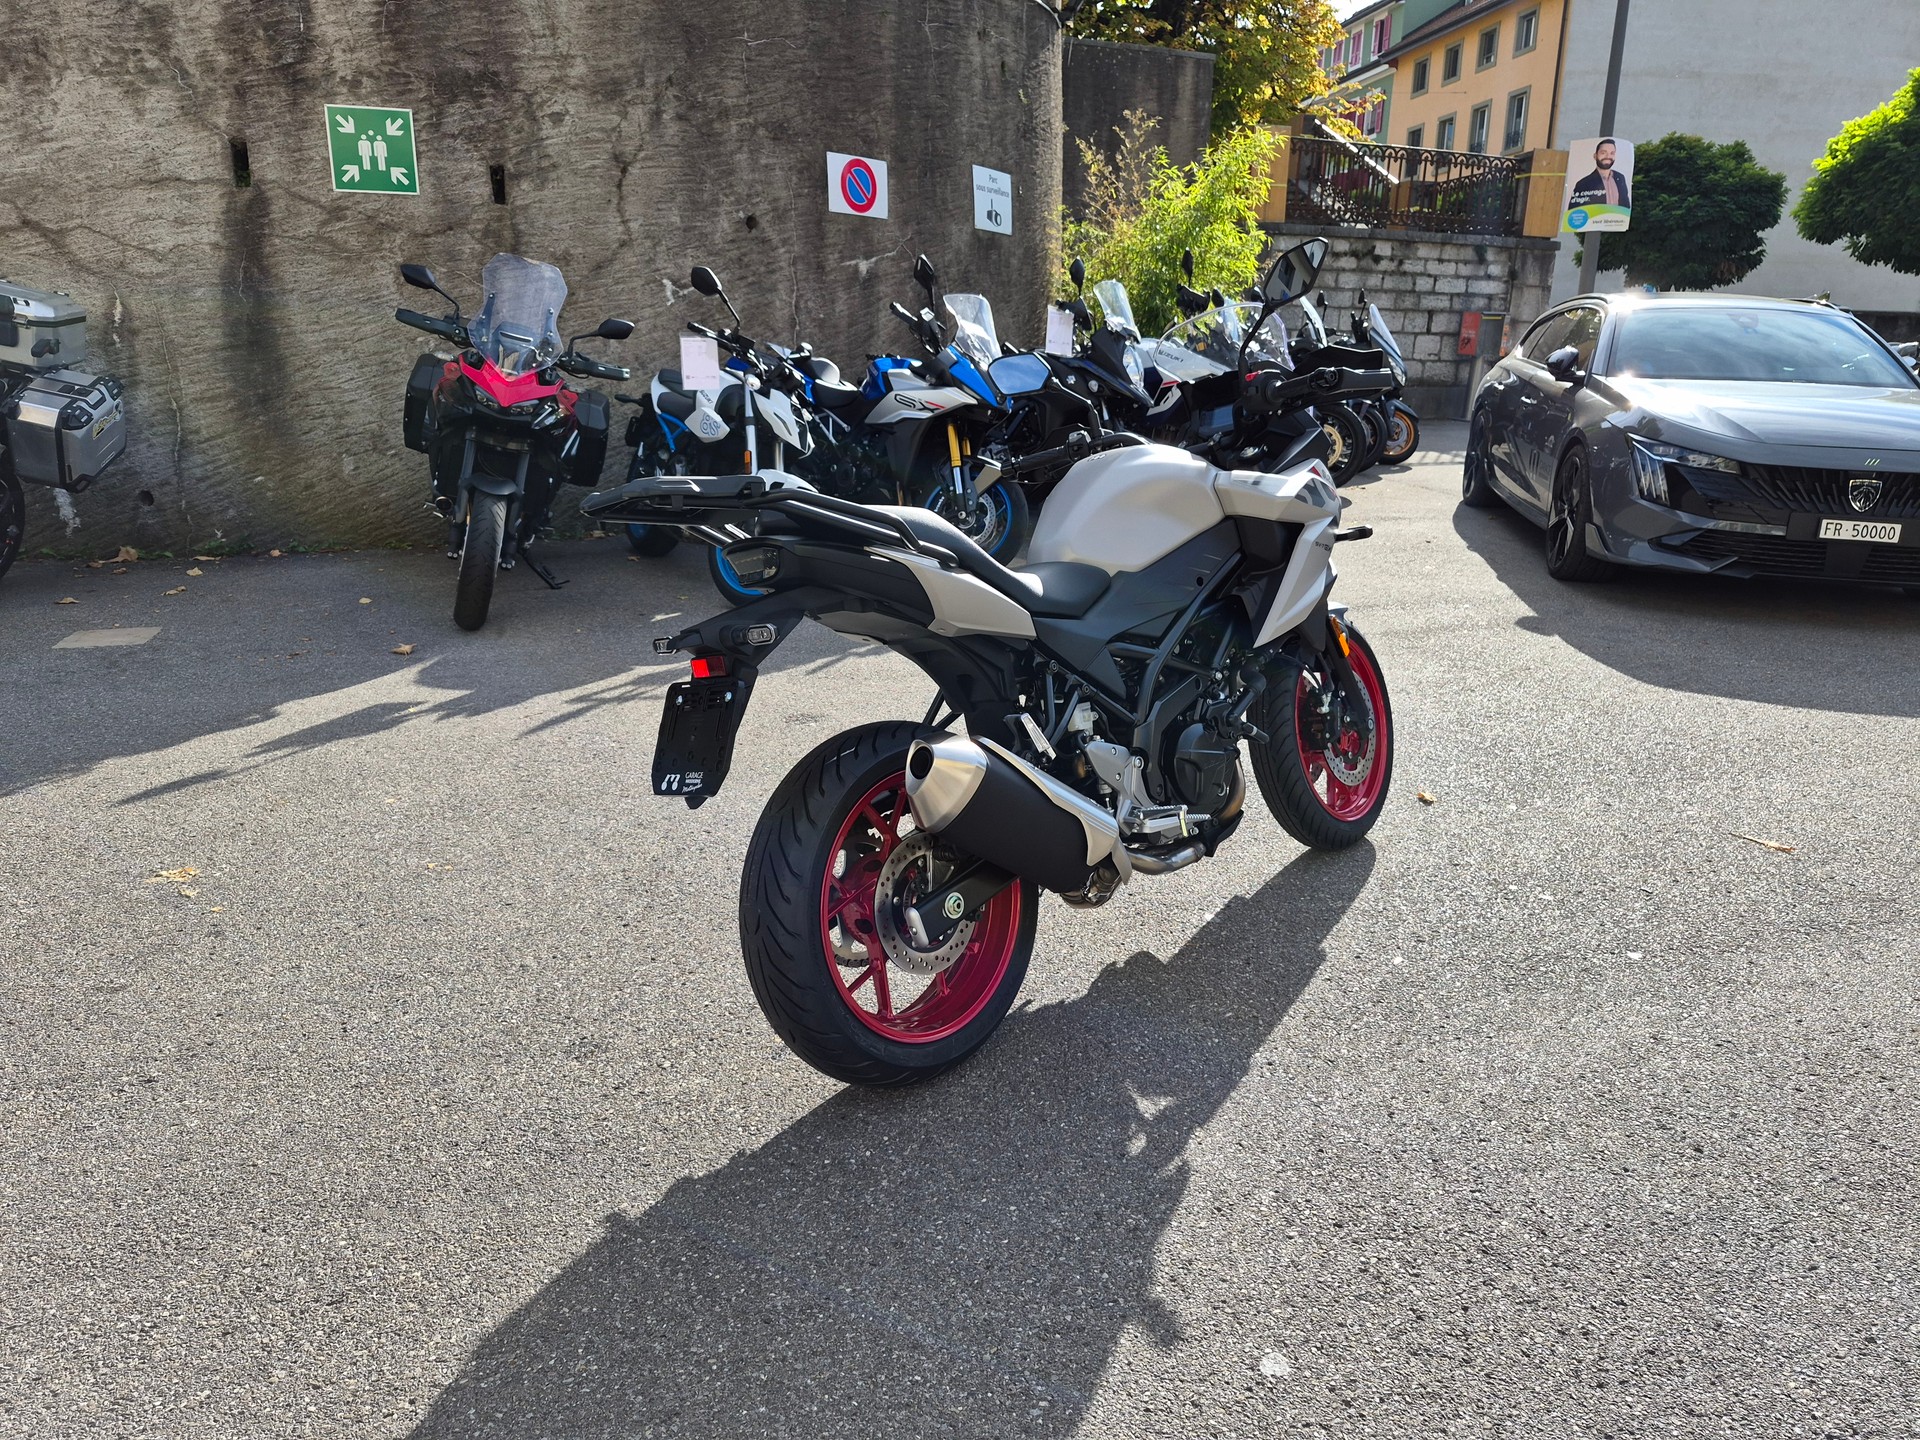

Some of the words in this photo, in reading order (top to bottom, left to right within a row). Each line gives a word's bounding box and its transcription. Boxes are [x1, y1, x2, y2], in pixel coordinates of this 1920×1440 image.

[988, 174, 998, 184] Parc
[976, 184, 986, 192] sous
[986, 186, 1009, 198] surveillance
[1580, 189, 1607, 197] courage
[1824, 522, 1843, 537] FR
[1851, 523, 1896, 540] 50000
[685, 771, 704, 779] GARAGE
